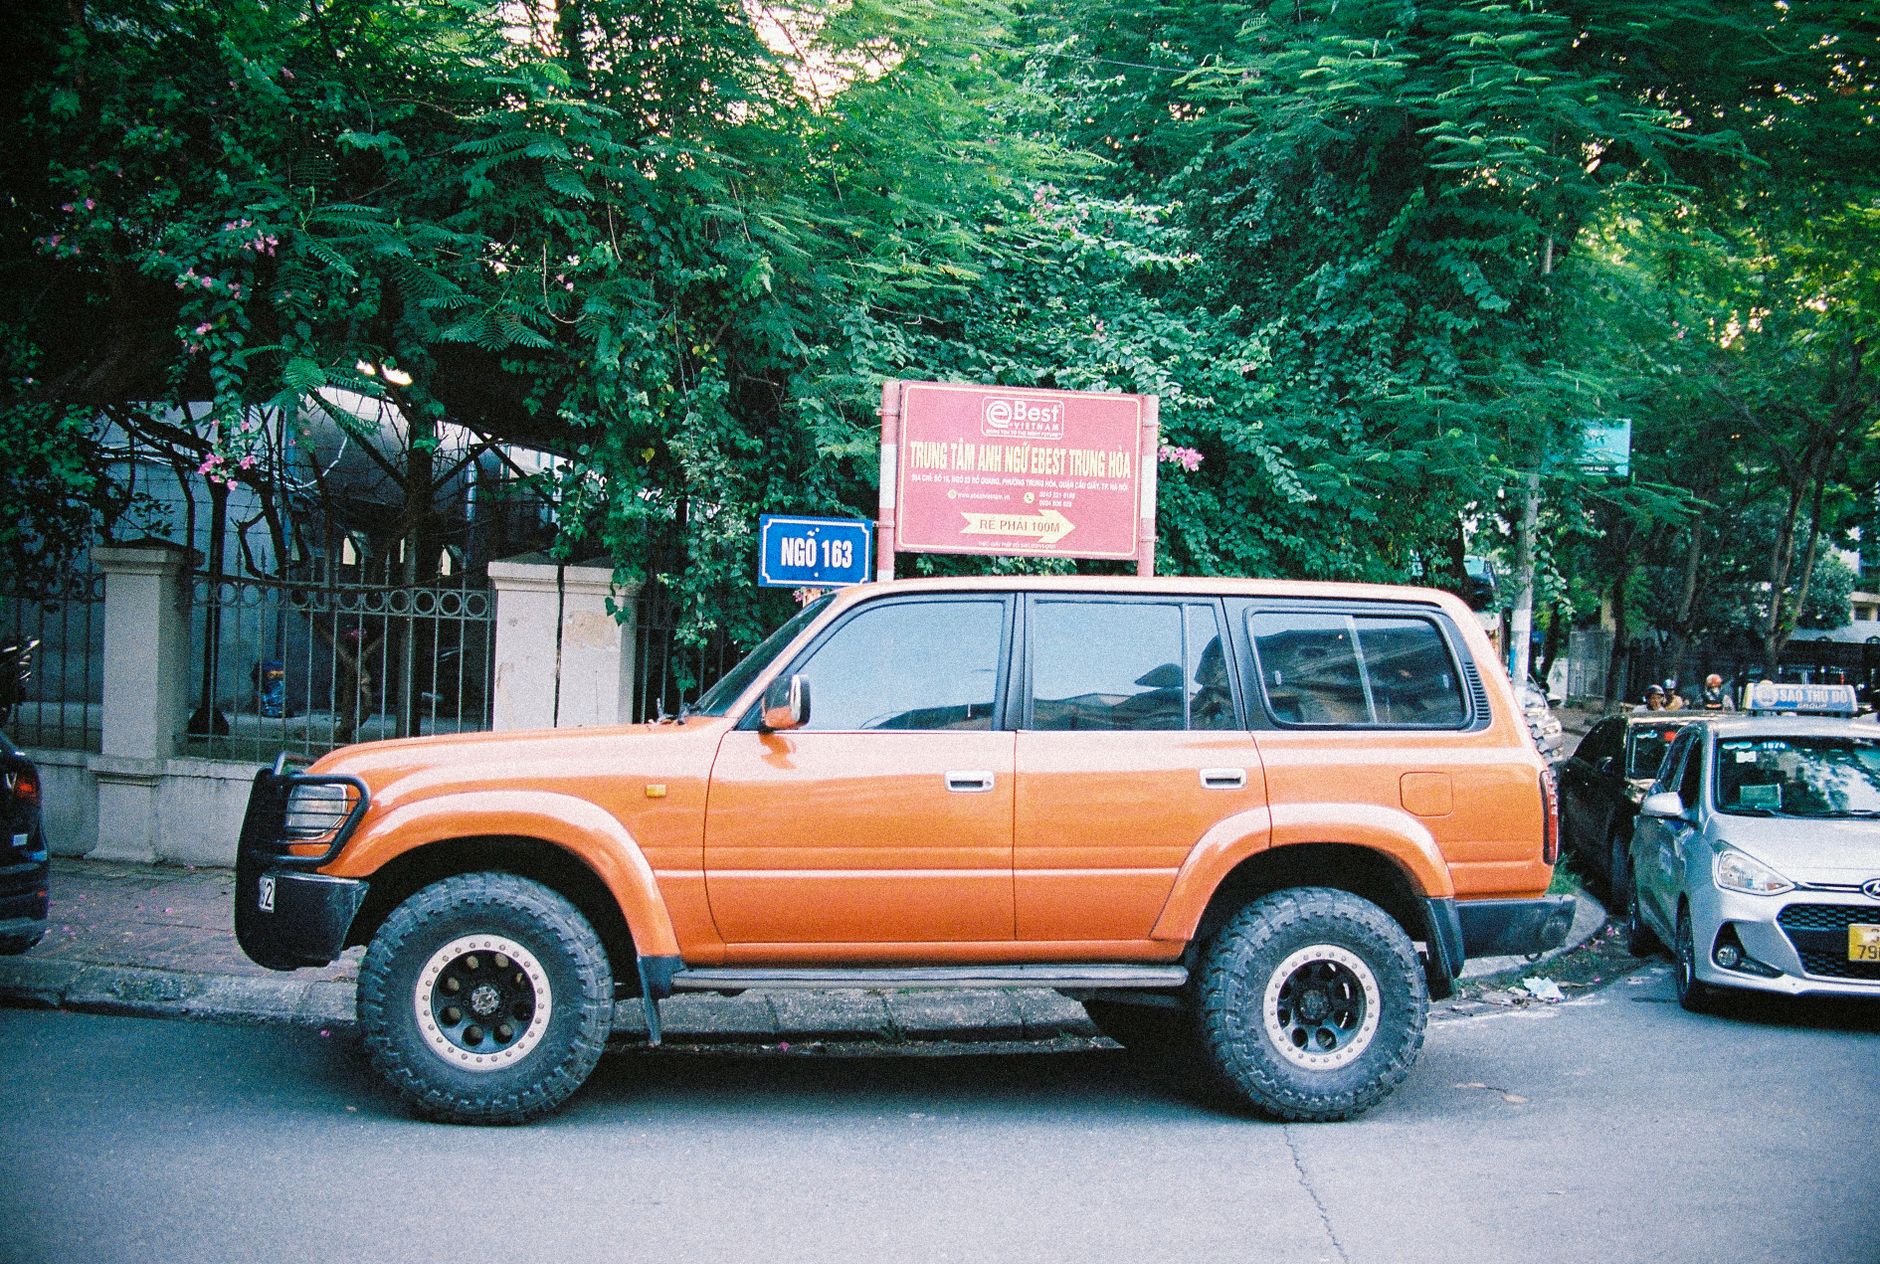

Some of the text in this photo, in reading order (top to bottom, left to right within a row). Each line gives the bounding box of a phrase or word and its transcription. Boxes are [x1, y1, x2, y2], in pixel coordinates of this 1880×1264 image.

[1014, 422, 1060, 431] VIETNAM
[910, 437, 1130, 478] TRUNG TÂM ANH NGỮ EBEST TRUNG HÒA
[1032, 522, 1060, 533] 100M
[781, 531, 852, 568] NGÕ 163
[1780, 689, 1803, 702] SAO
[1857, 944, 1880, 960] 79
